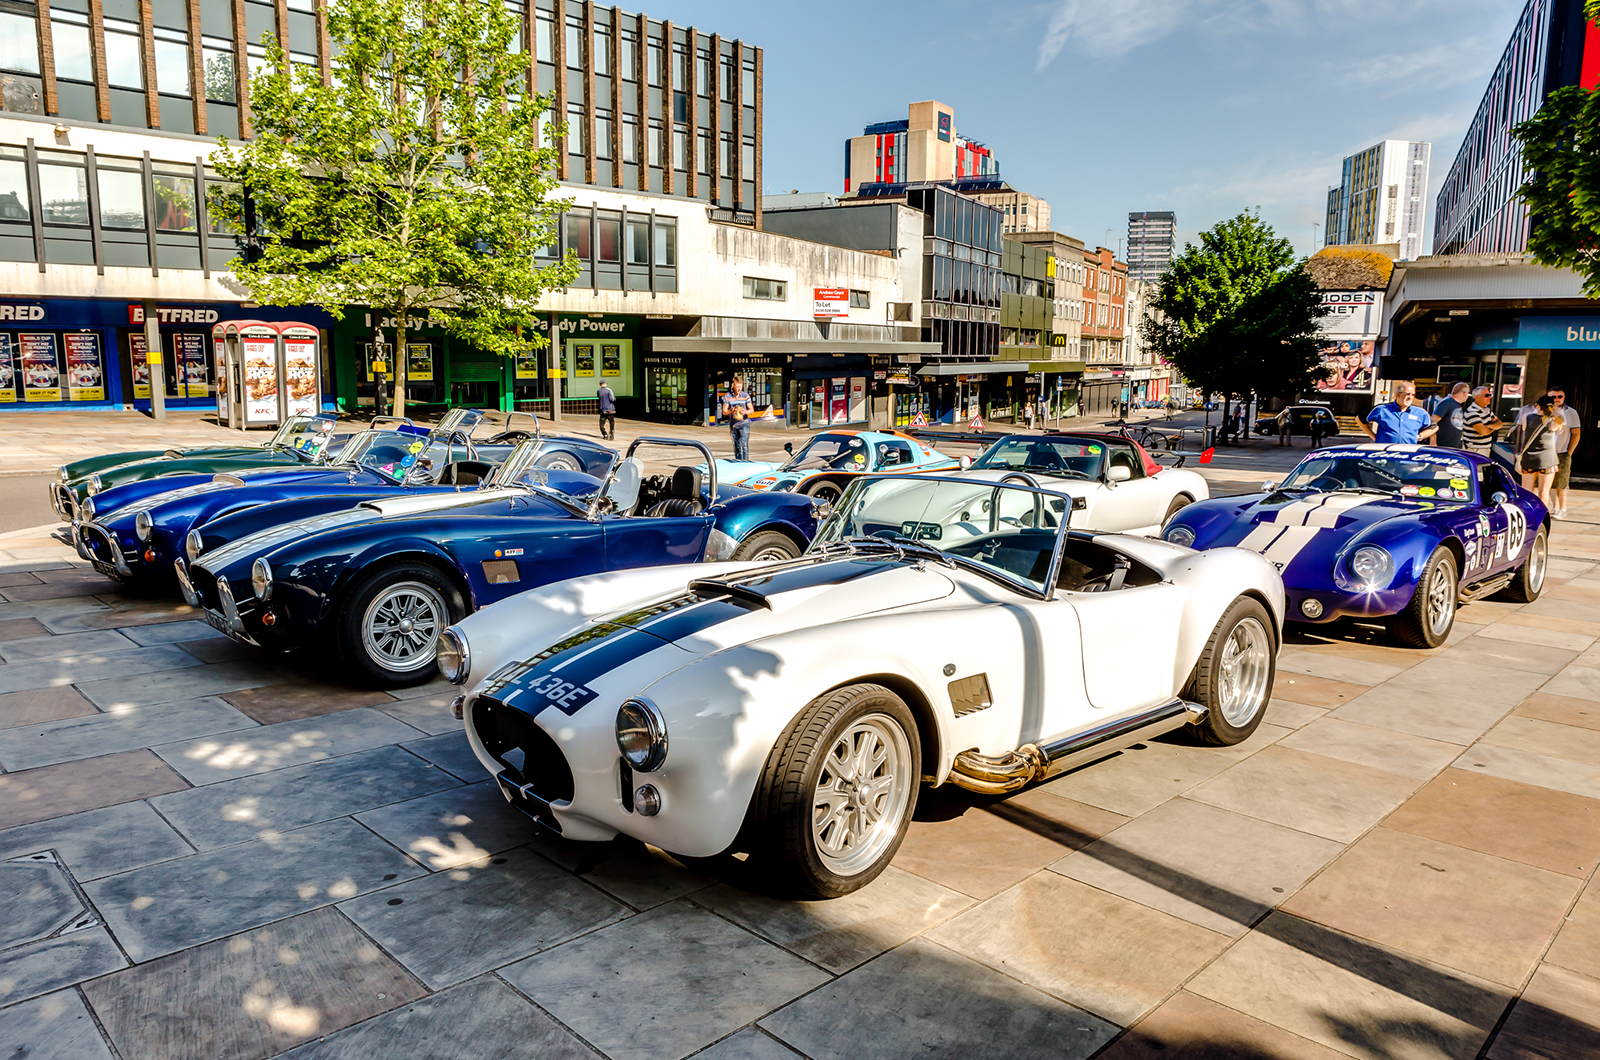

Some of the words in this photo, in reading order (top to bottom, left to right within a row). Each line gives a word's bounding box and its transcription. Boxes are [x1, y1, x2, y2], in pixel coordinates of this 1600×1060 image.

[1325, 294, 1375, 303] IDDEN
[133, 308, 218, 323] BTFRED
[531, 318, 577, 333] Pady
[580, 318, 625, 332] Power
[1566, 326, 1600, 341] blu
[248, 370, 273, 379] HOT
[289, 370, 313, 379] HOT
[1315, 451, 1366, 459] Daytona
[1367, 451, 1409, 459] Cobra
[1411, 454, 1458, 464] Coupe
[1510, 511, 1524, 550] 69
[528, 674, 589, 709] 436E
